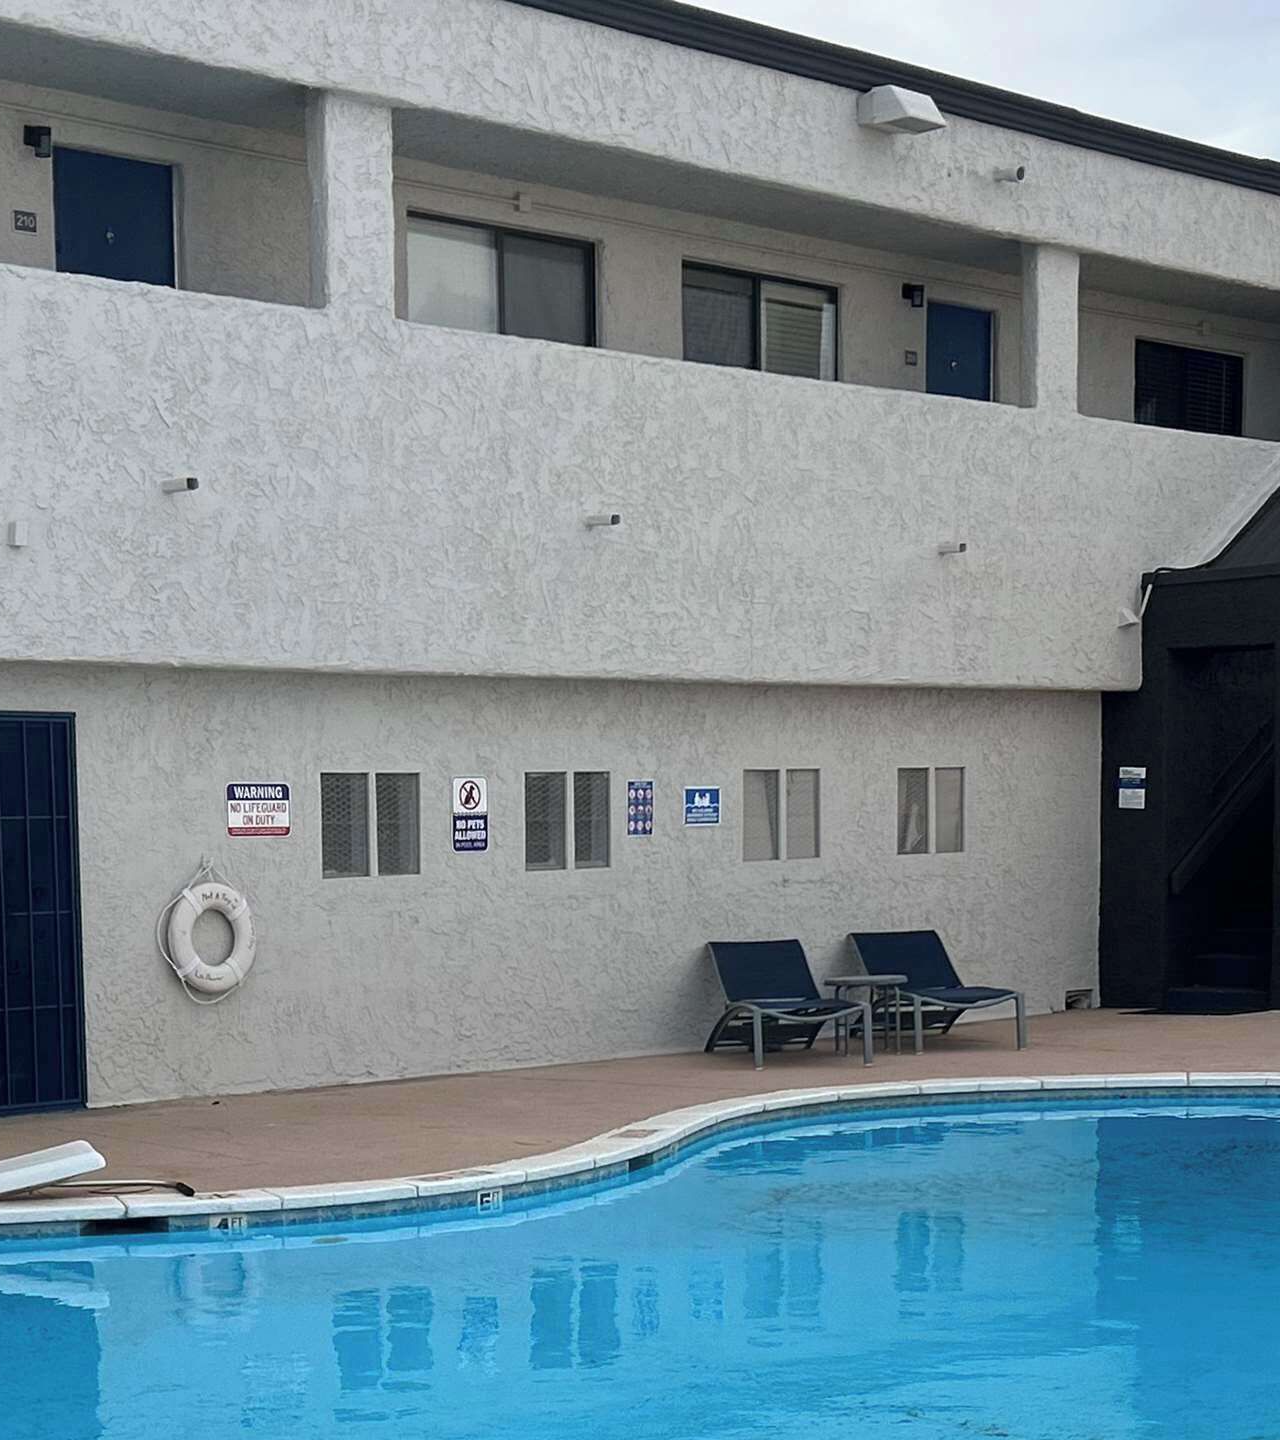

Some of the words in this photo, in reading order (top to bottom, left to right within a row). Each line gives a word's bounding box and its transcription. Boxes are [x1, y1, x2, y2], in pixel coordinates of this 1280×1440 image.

[17, 215, 35, 228] 210
[233, 786, 283, 799] WARNING
[230, 803, 241, 813] NO
[243, 803, 287, 813] LIFEGUARD
[243, 815, 254, 825] ON
[256, 815, 275, 825] DUTY
[456, 820, 466, 829] NO
[467, 819, 485, 829] PETS
[454, 830, 486, 840] ALLOWED
